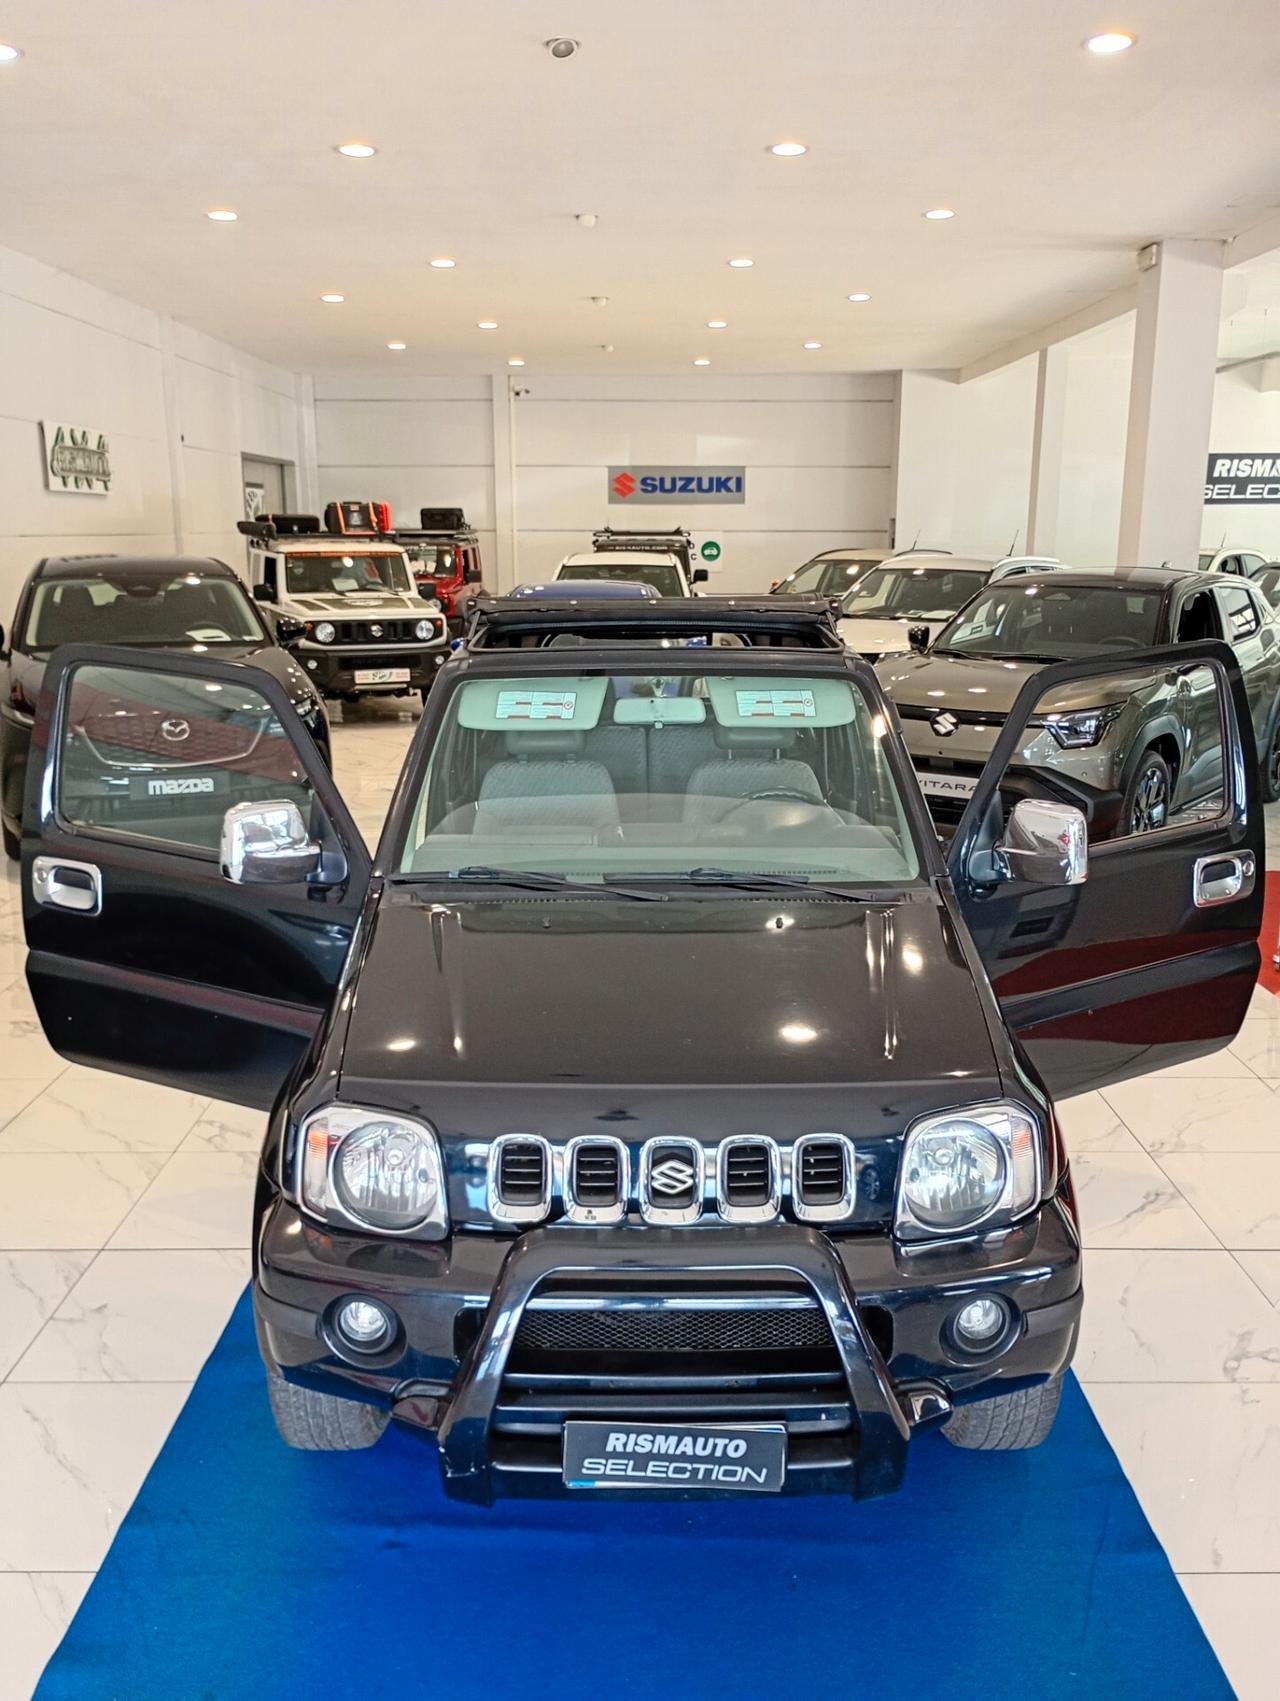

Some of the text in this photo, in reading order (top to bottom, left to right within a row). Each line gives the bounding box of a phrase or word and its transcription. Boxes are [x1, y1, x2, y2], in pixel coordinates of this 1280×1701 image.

[640, 476, 742, 494] SUZUKI
[919, 780, 977, 792] ITARA
[606, 1432, 747, 1458] RISMAUTO
[581, 1458, 767, 1484] SELECTION
